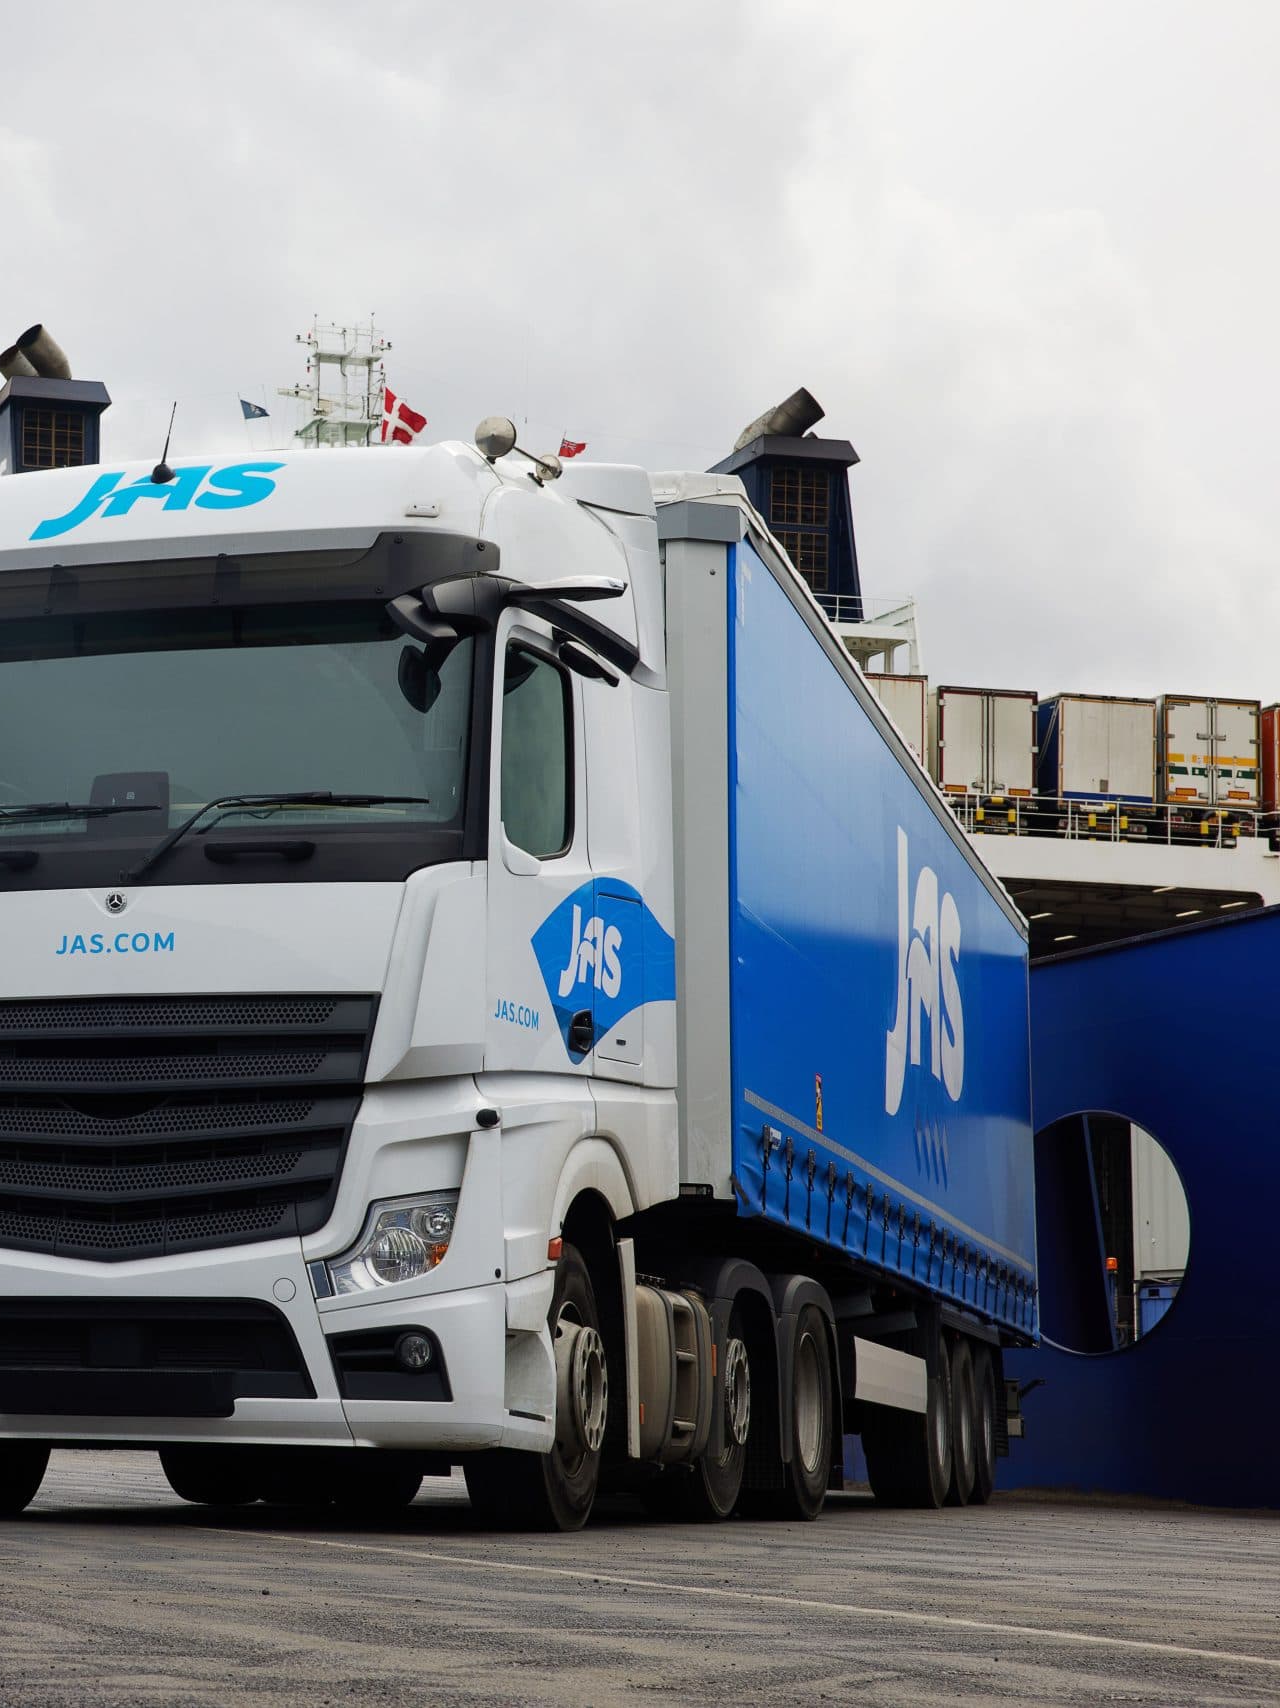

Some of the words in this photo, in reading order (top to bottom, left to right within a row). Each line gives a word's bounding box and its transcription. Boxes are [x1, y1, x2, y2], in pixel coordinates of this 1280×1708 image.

[28, 462, 287, 541] JAS
[55, 931, 176, 955] JAS.COM
[558, 903, 622, 999] JAS
[885, 824, 965, 1116] JAS
[494, 998, 539, 1031] JAS.COM
